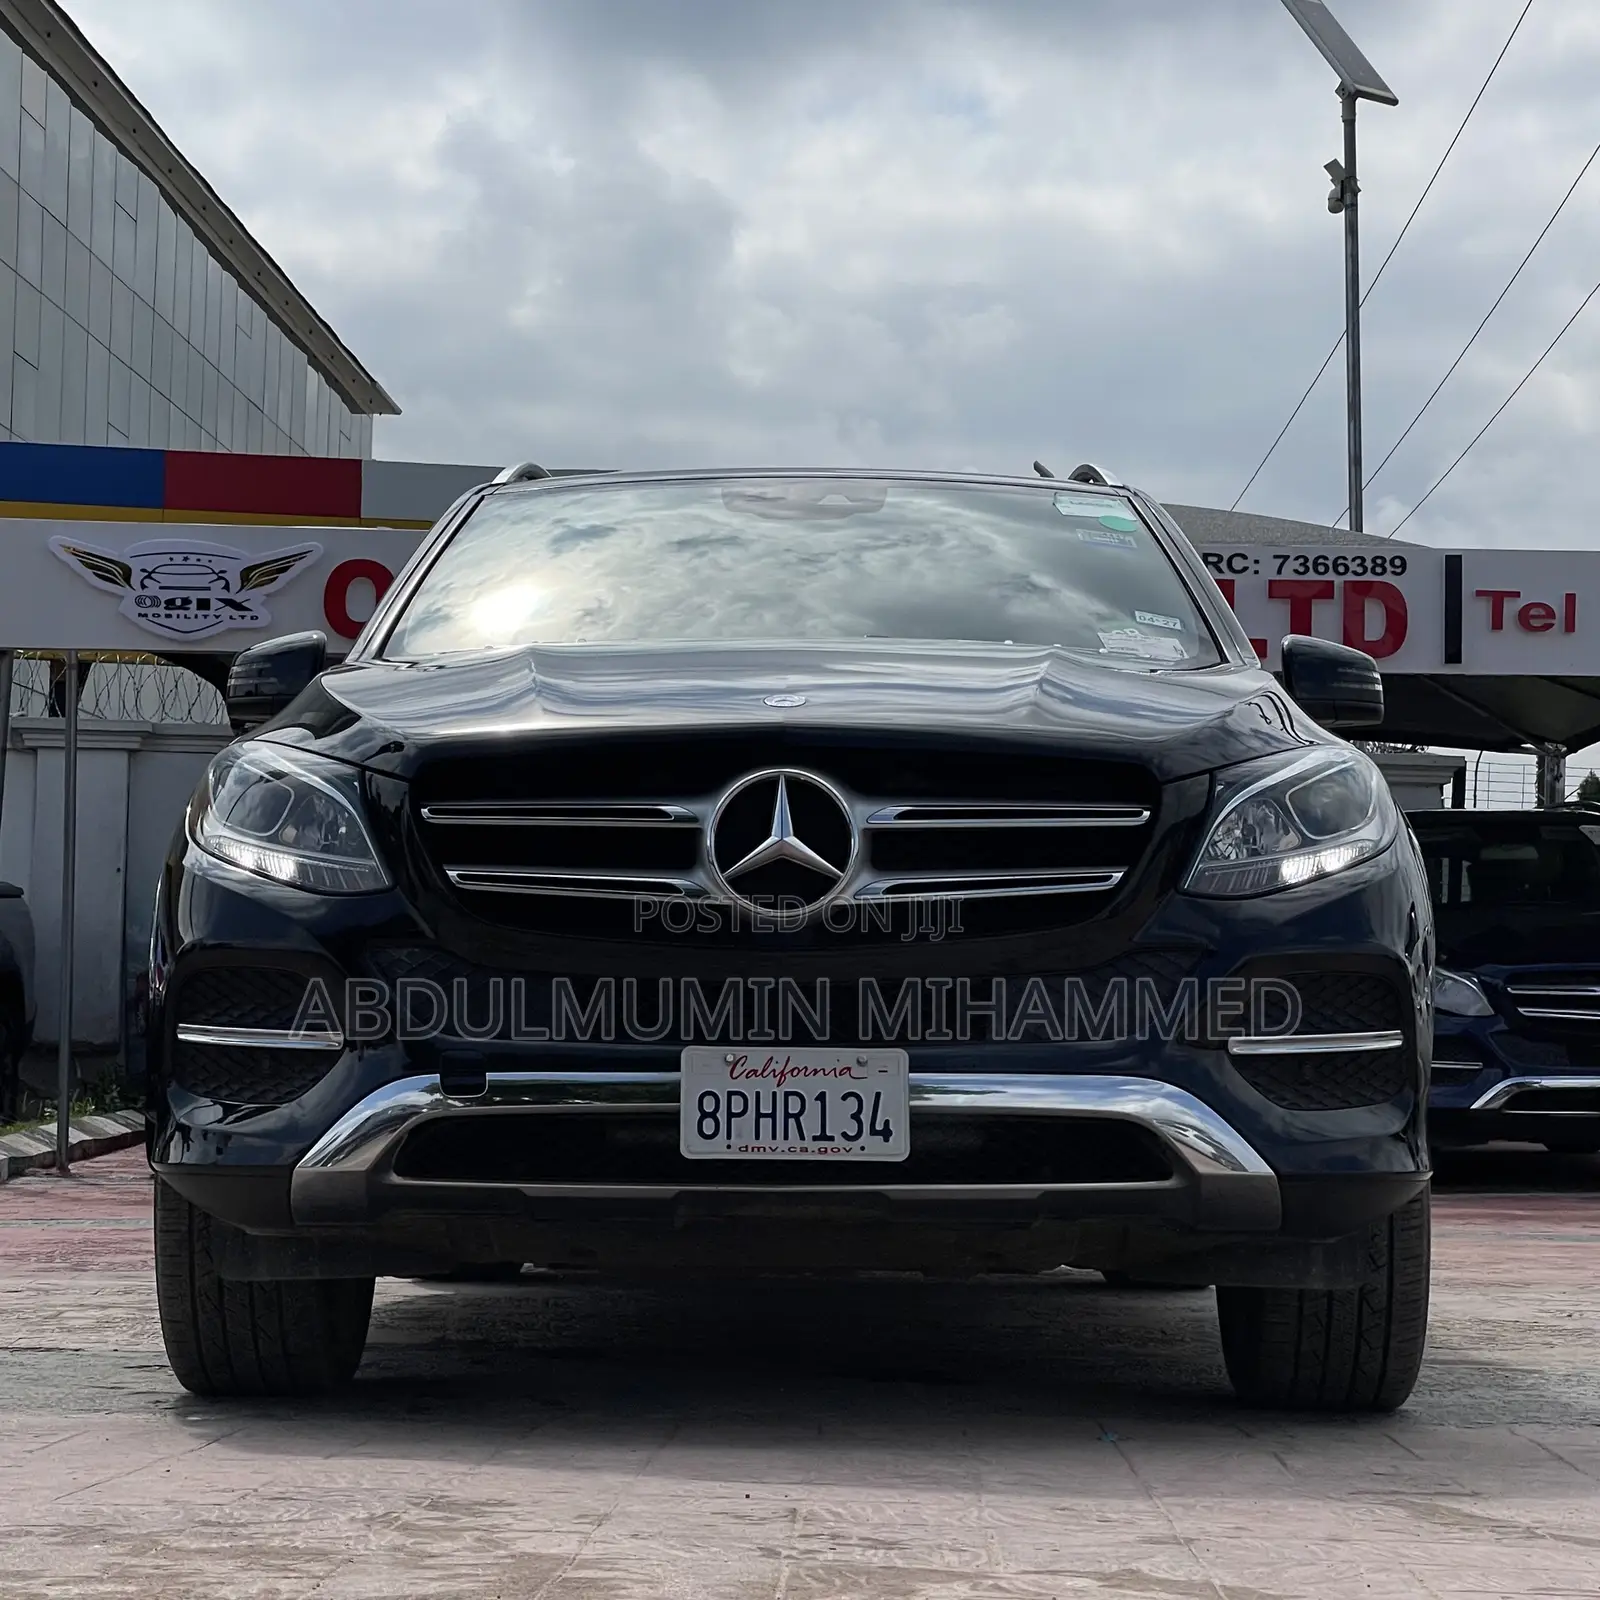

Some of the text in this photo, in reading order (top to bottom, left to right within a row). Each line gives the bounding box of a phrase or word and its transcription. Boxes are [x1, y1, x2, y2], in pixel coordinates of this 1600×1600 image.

[1202, 552, 1408, 576] RC: 7366389
[137, 611, 221, 620] MOBILITY
[1475, 589, 1576, 633] Tel
[729, 1054, 868, 1088] California
[696, 1089, 894, 1143] 8PHR134
[737, 1143, 854, 1155] dmv.ca.gov
